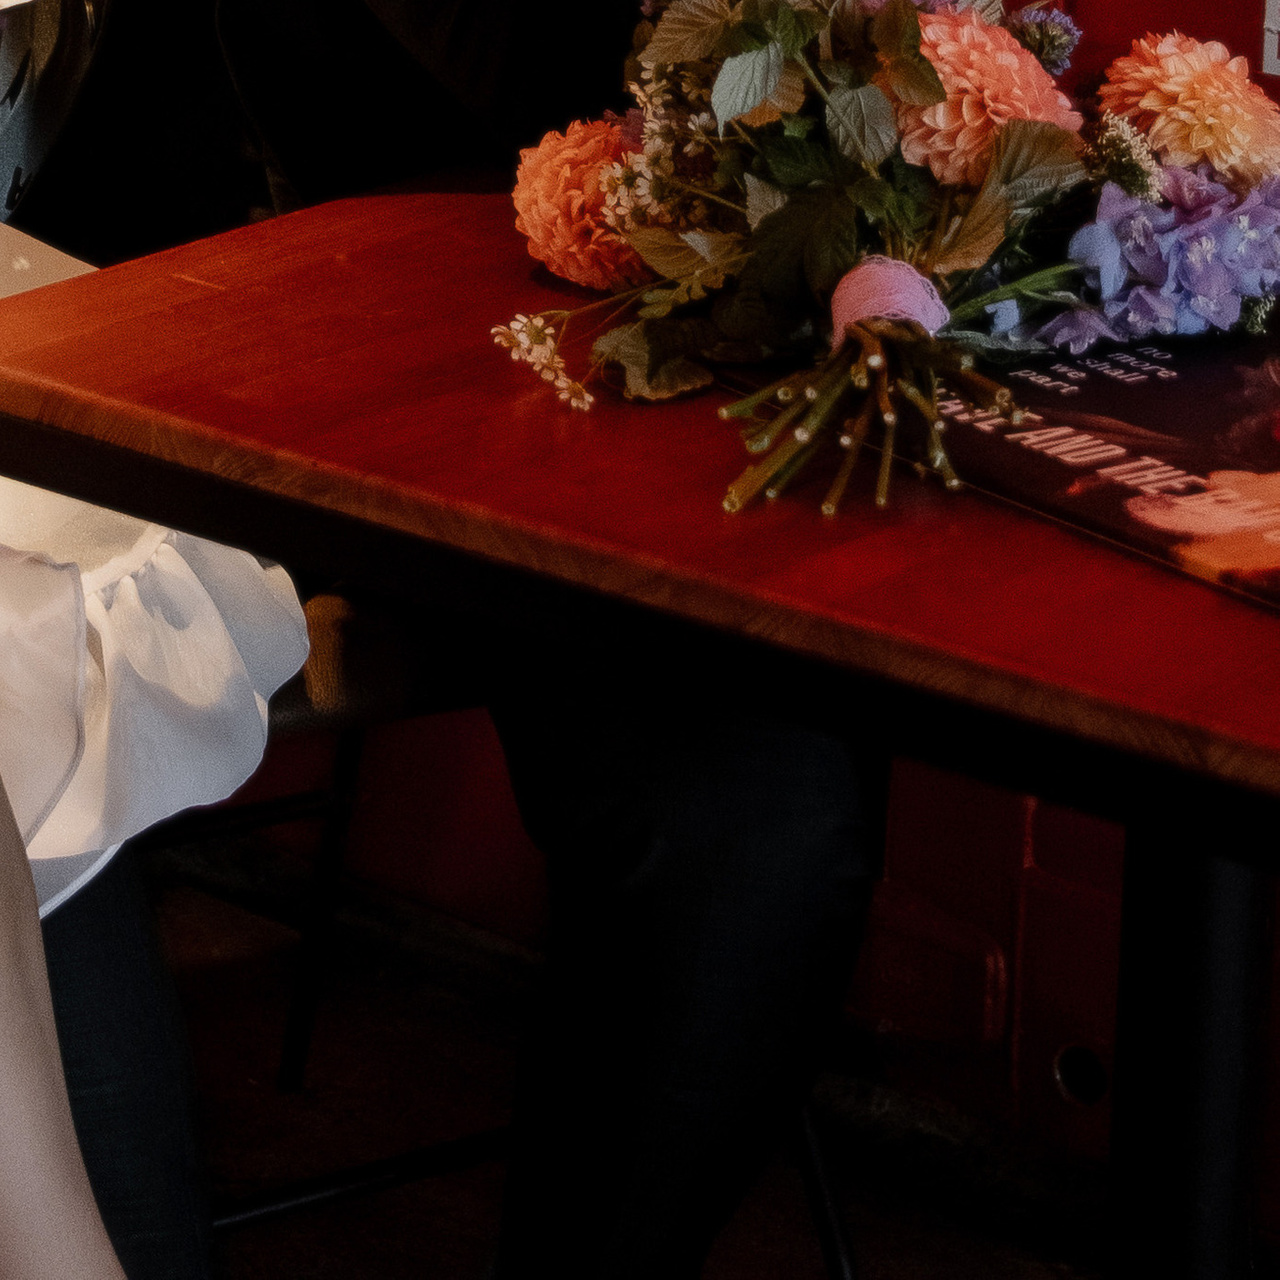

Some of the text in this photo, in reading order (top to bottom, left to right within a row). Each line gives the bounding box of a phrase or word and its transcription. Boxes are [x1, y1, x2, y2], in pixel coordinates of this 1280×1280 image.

[1107, 352, 1178, 379] more
[1135, 346, 1173, 360] no
[1008, 369, 1081, 395] part
[1049, 362, 1088, 380] we
[1076, 357, 1150, 383] shall
[1004, 425, 1128, 467] AND
[1095, 455, 1206, 494] THE
